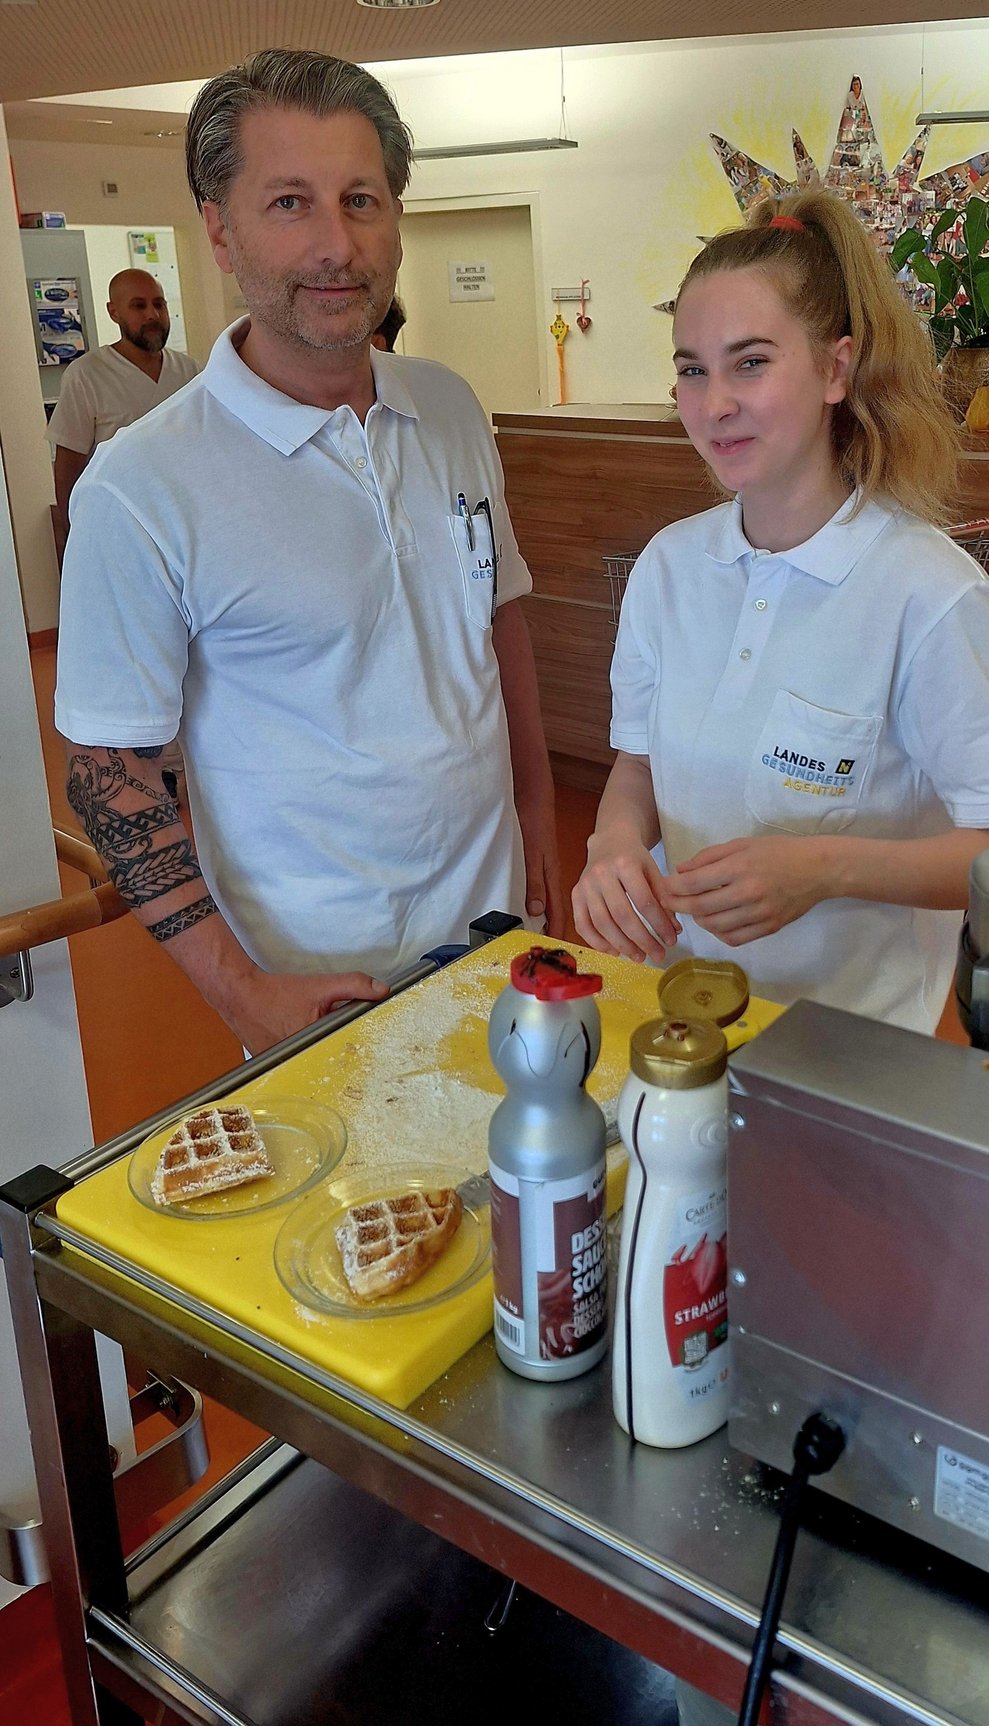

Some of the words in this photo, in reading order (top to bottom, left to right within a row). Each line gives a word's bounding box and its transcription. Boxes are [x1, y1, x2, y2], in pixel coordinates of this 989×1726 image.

[761, 753, 856, 786] GESUNDHEITS
[773, 746, 826, 772] LANDES
[783, 778, 847, 798] AGENTUR
